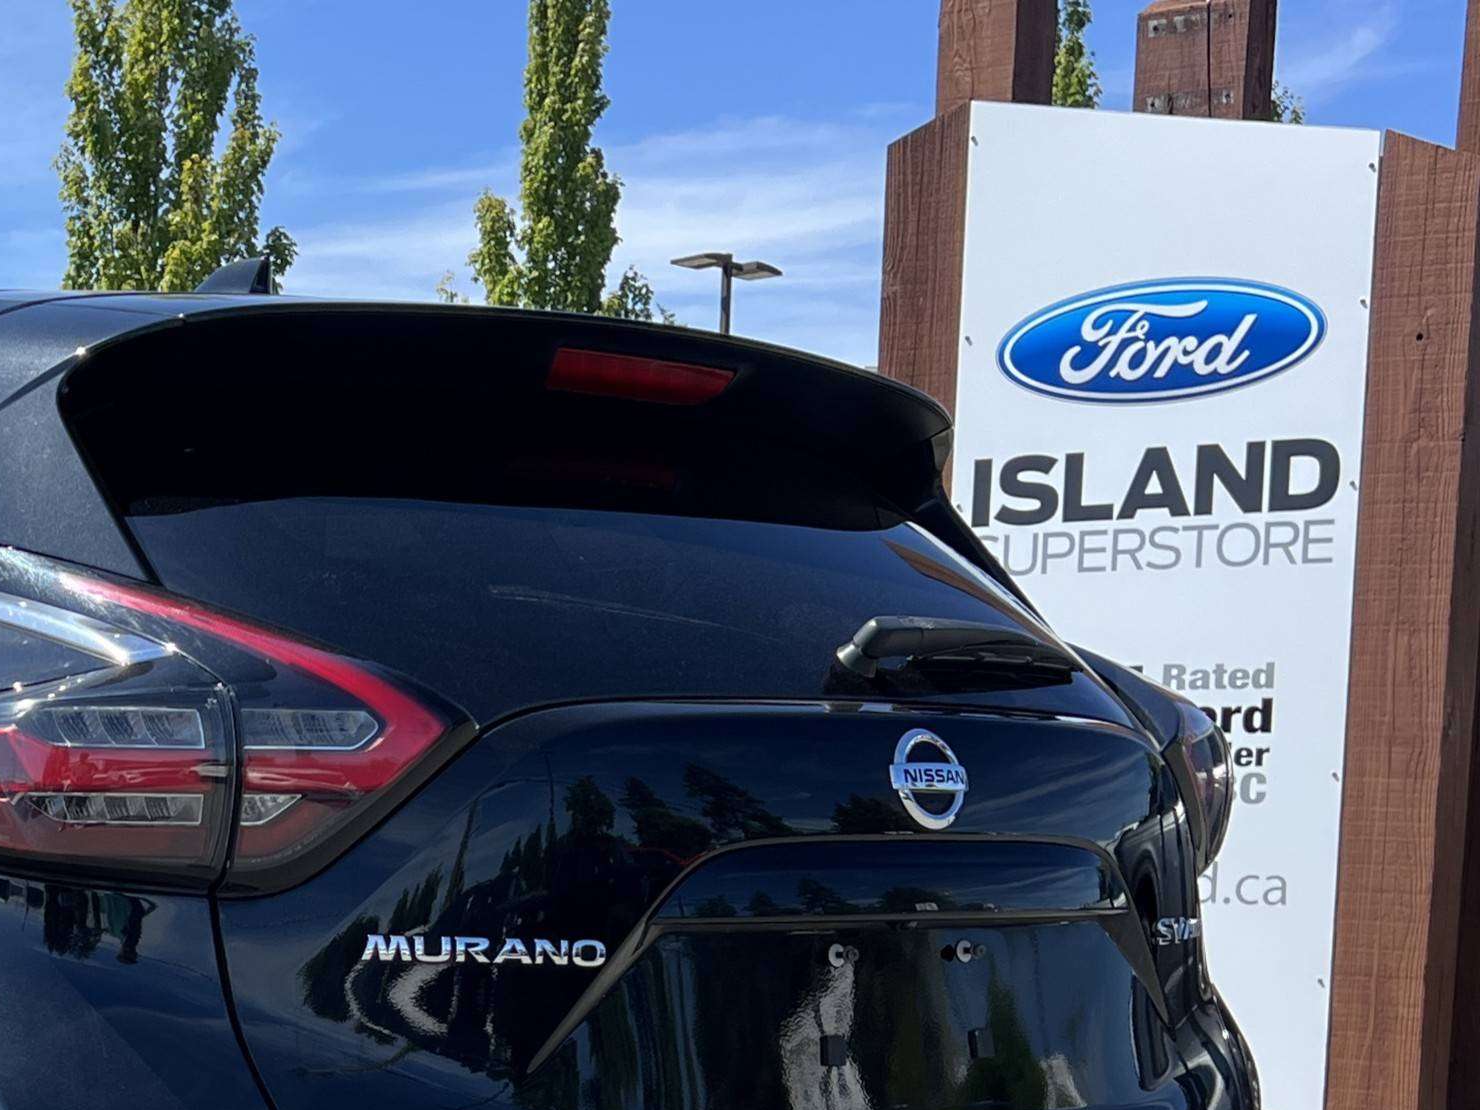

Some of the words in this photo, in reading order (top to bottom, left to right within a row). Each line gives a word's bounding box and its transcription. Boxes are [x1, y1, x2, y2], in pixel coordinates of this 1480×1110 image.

[1059, 299, 1258, 385] Ford
[971, 438, 1341, 528] ISLAND
[1162, 661, 1276, 691] Rated
[903, 768, 965, 785] NISSAN
[361, 934, 607, 968] MURANO
